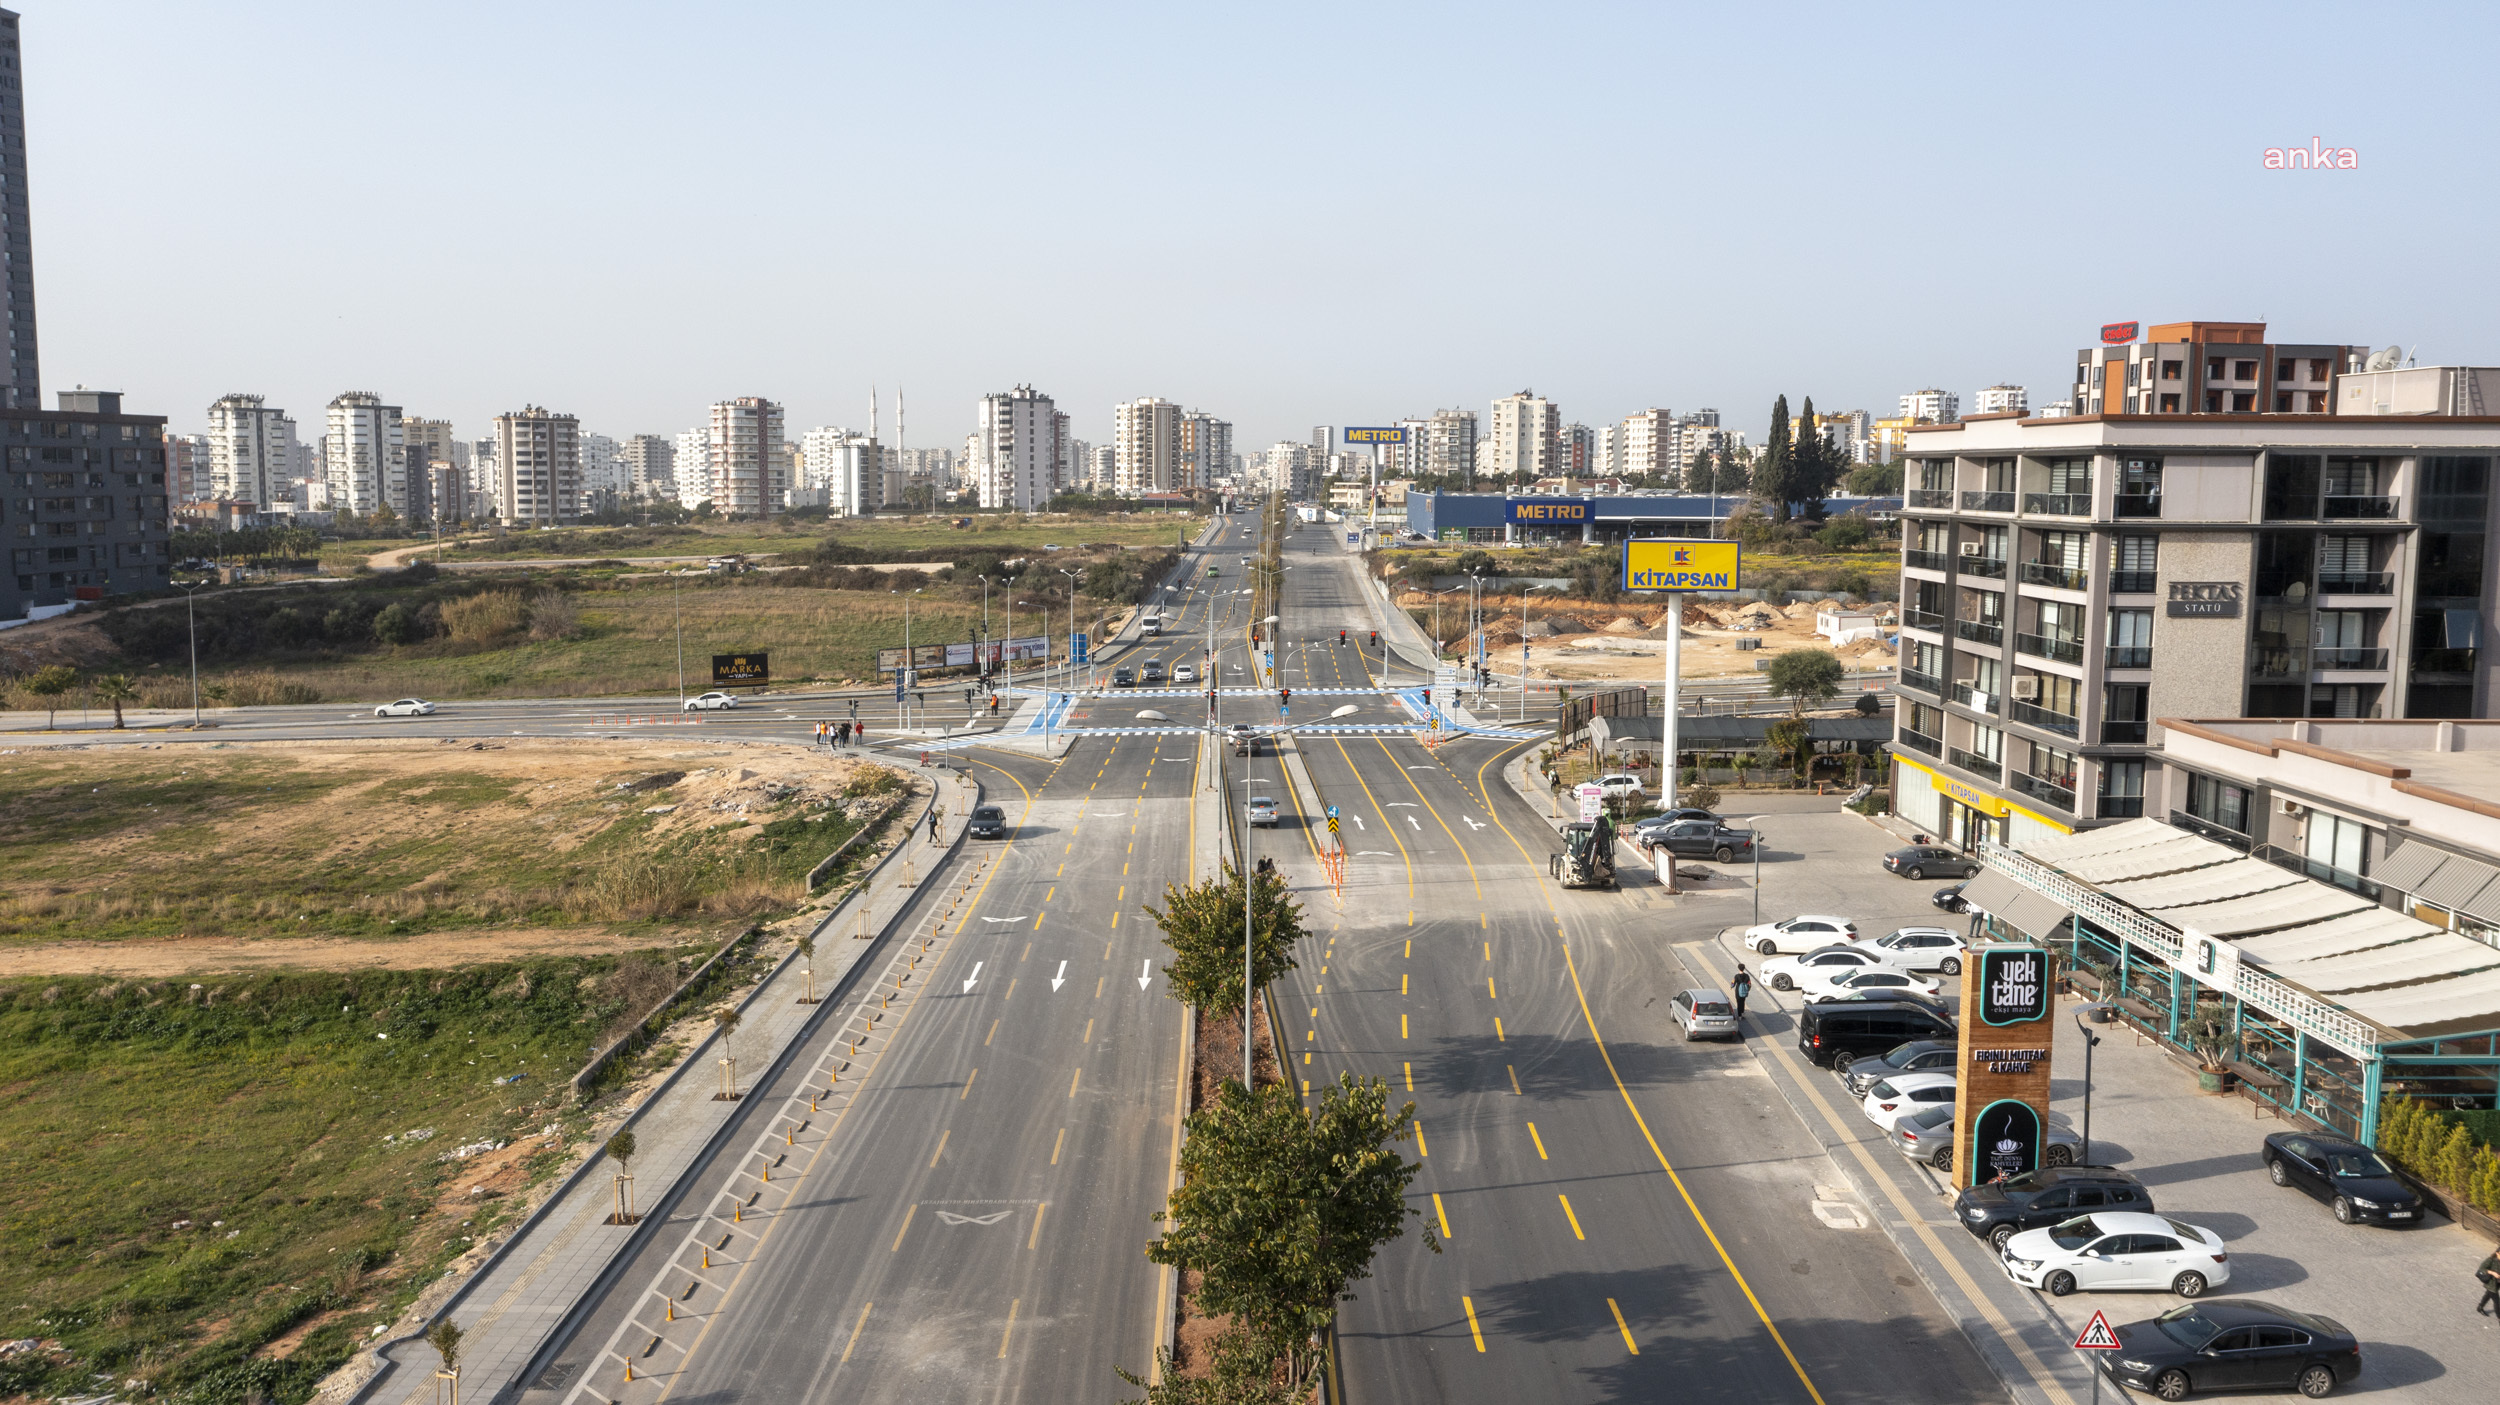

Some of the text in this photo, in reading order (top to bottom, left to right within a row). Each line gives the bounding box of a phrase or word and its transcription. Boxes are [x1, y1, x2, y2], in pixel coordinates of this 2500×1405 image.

[1349, 430, 1401, 441] METRO
[1517, 504, 1585, 519] METRO
[1633, 568, 1728, 587] KİTAPSAN
[2185, 603, 2221, 612] STATÜ
[720, 664, 761, 674] MARKA
[1999, 953, 2036, 988] yek
[1992, 980, 2039, 1006] tane
[2008, 1048, 2046, 1061] MUTFAK
[1988, 1061, 2030, 1073] & KAHVE
